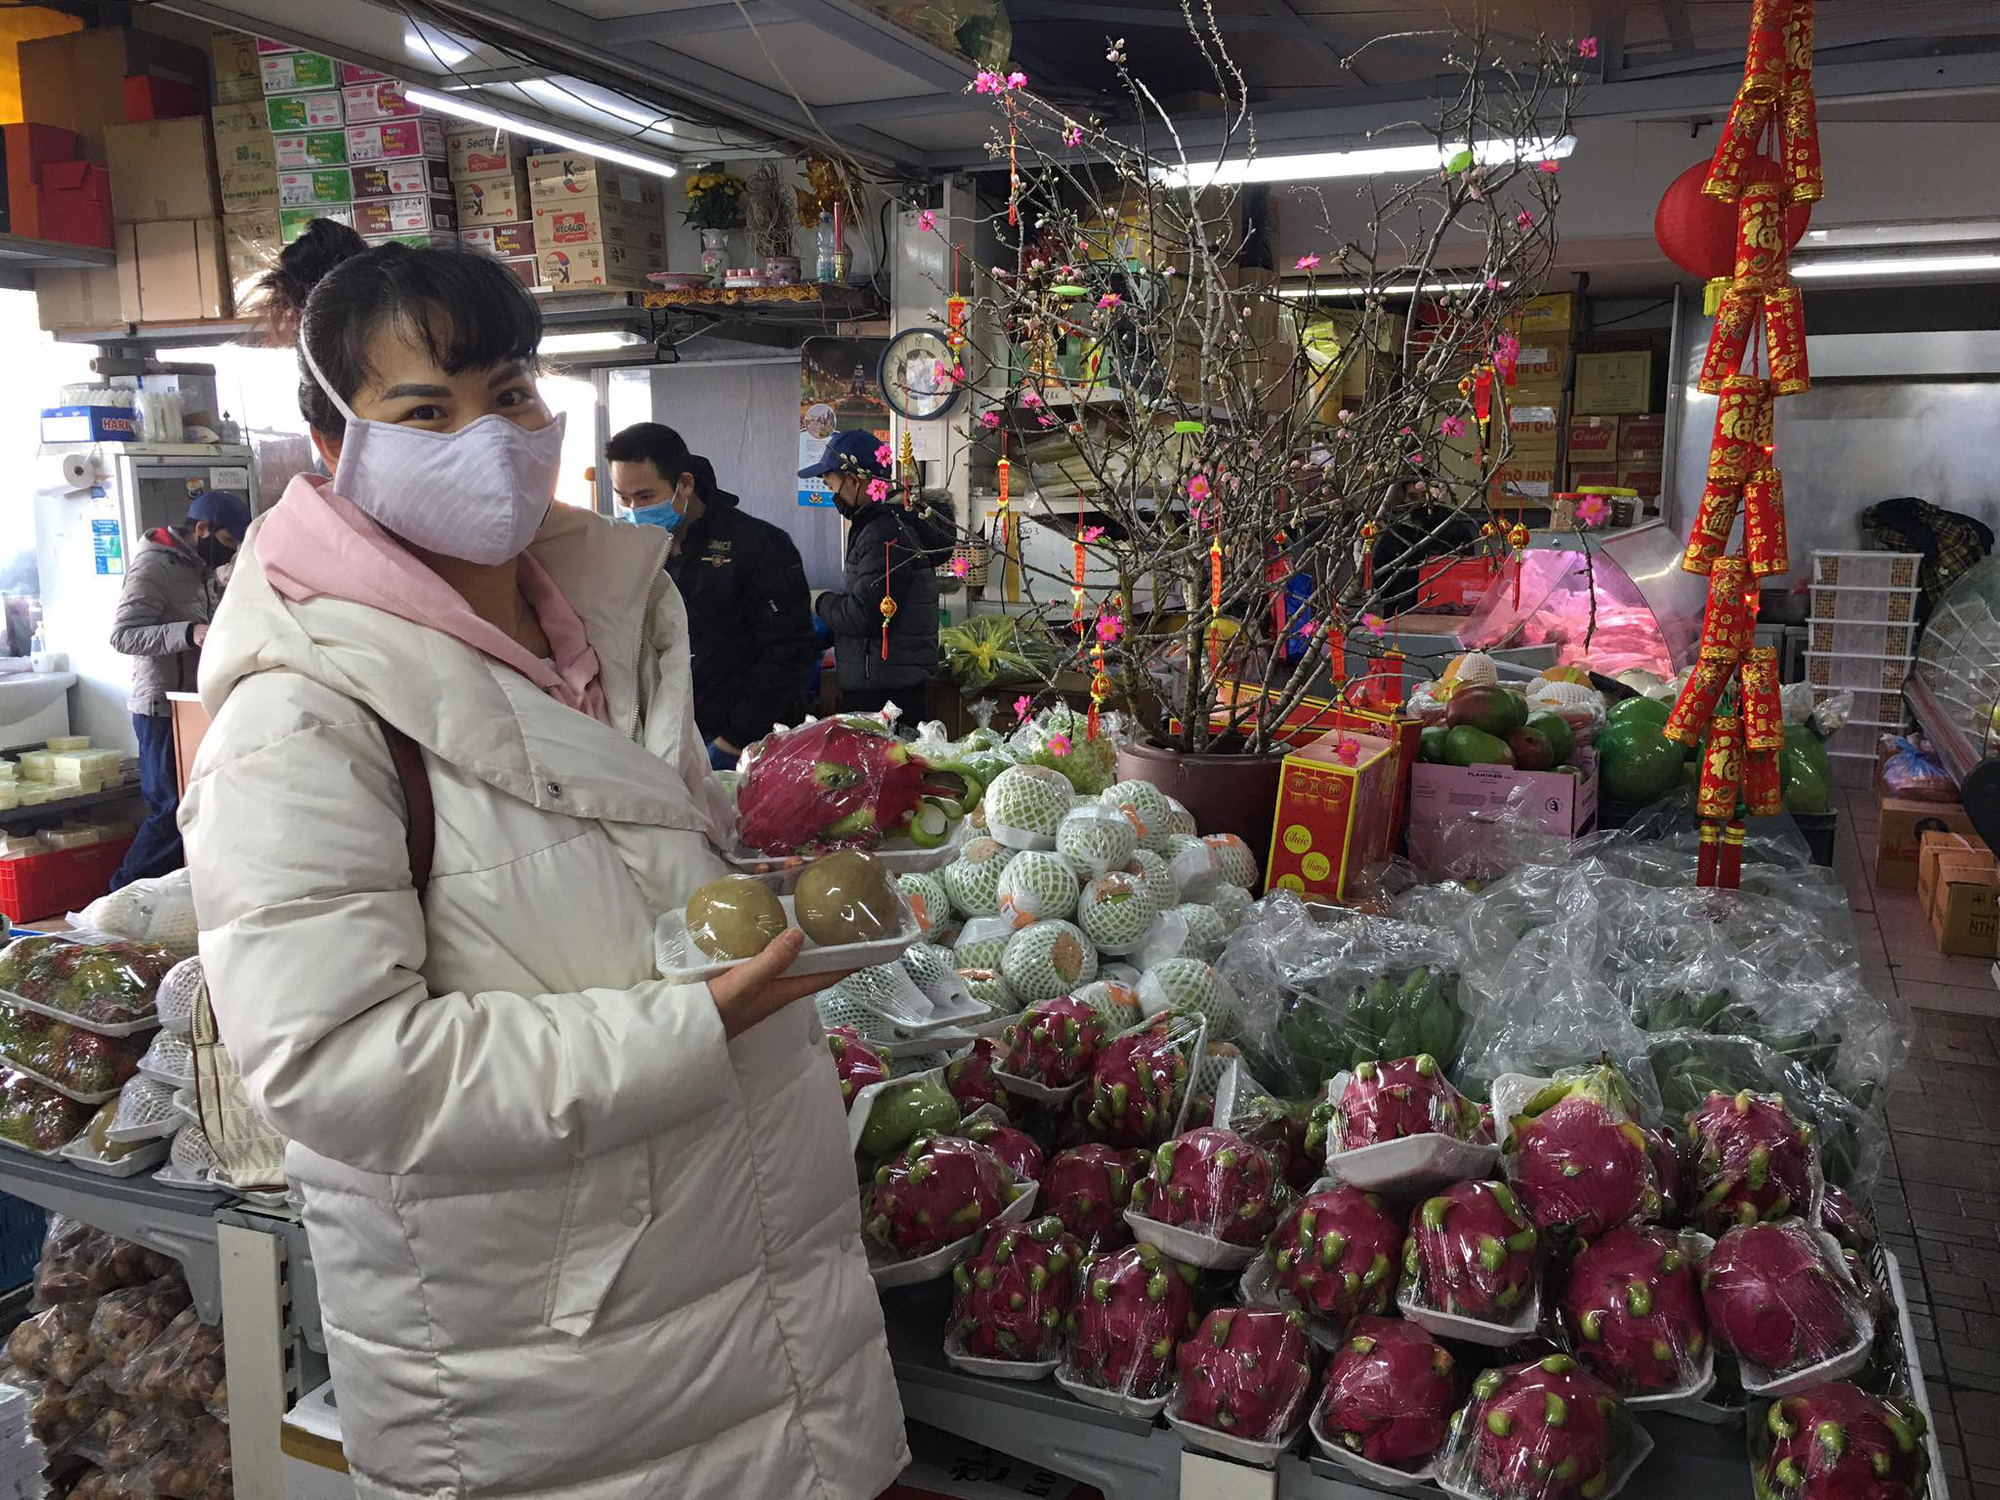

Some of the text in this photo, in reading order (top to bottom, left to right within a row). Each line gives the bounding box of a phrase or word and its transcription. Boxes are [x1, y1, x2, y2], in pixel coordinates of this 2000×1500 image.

[467, 136, 504, 149] Seafod
[1742, 201, 1783, 262] 福
[103, 417, 134, 431] HARI
[1719, 393, 1757, 443] 福
[1284, 830, 1310, 847] Chúc
